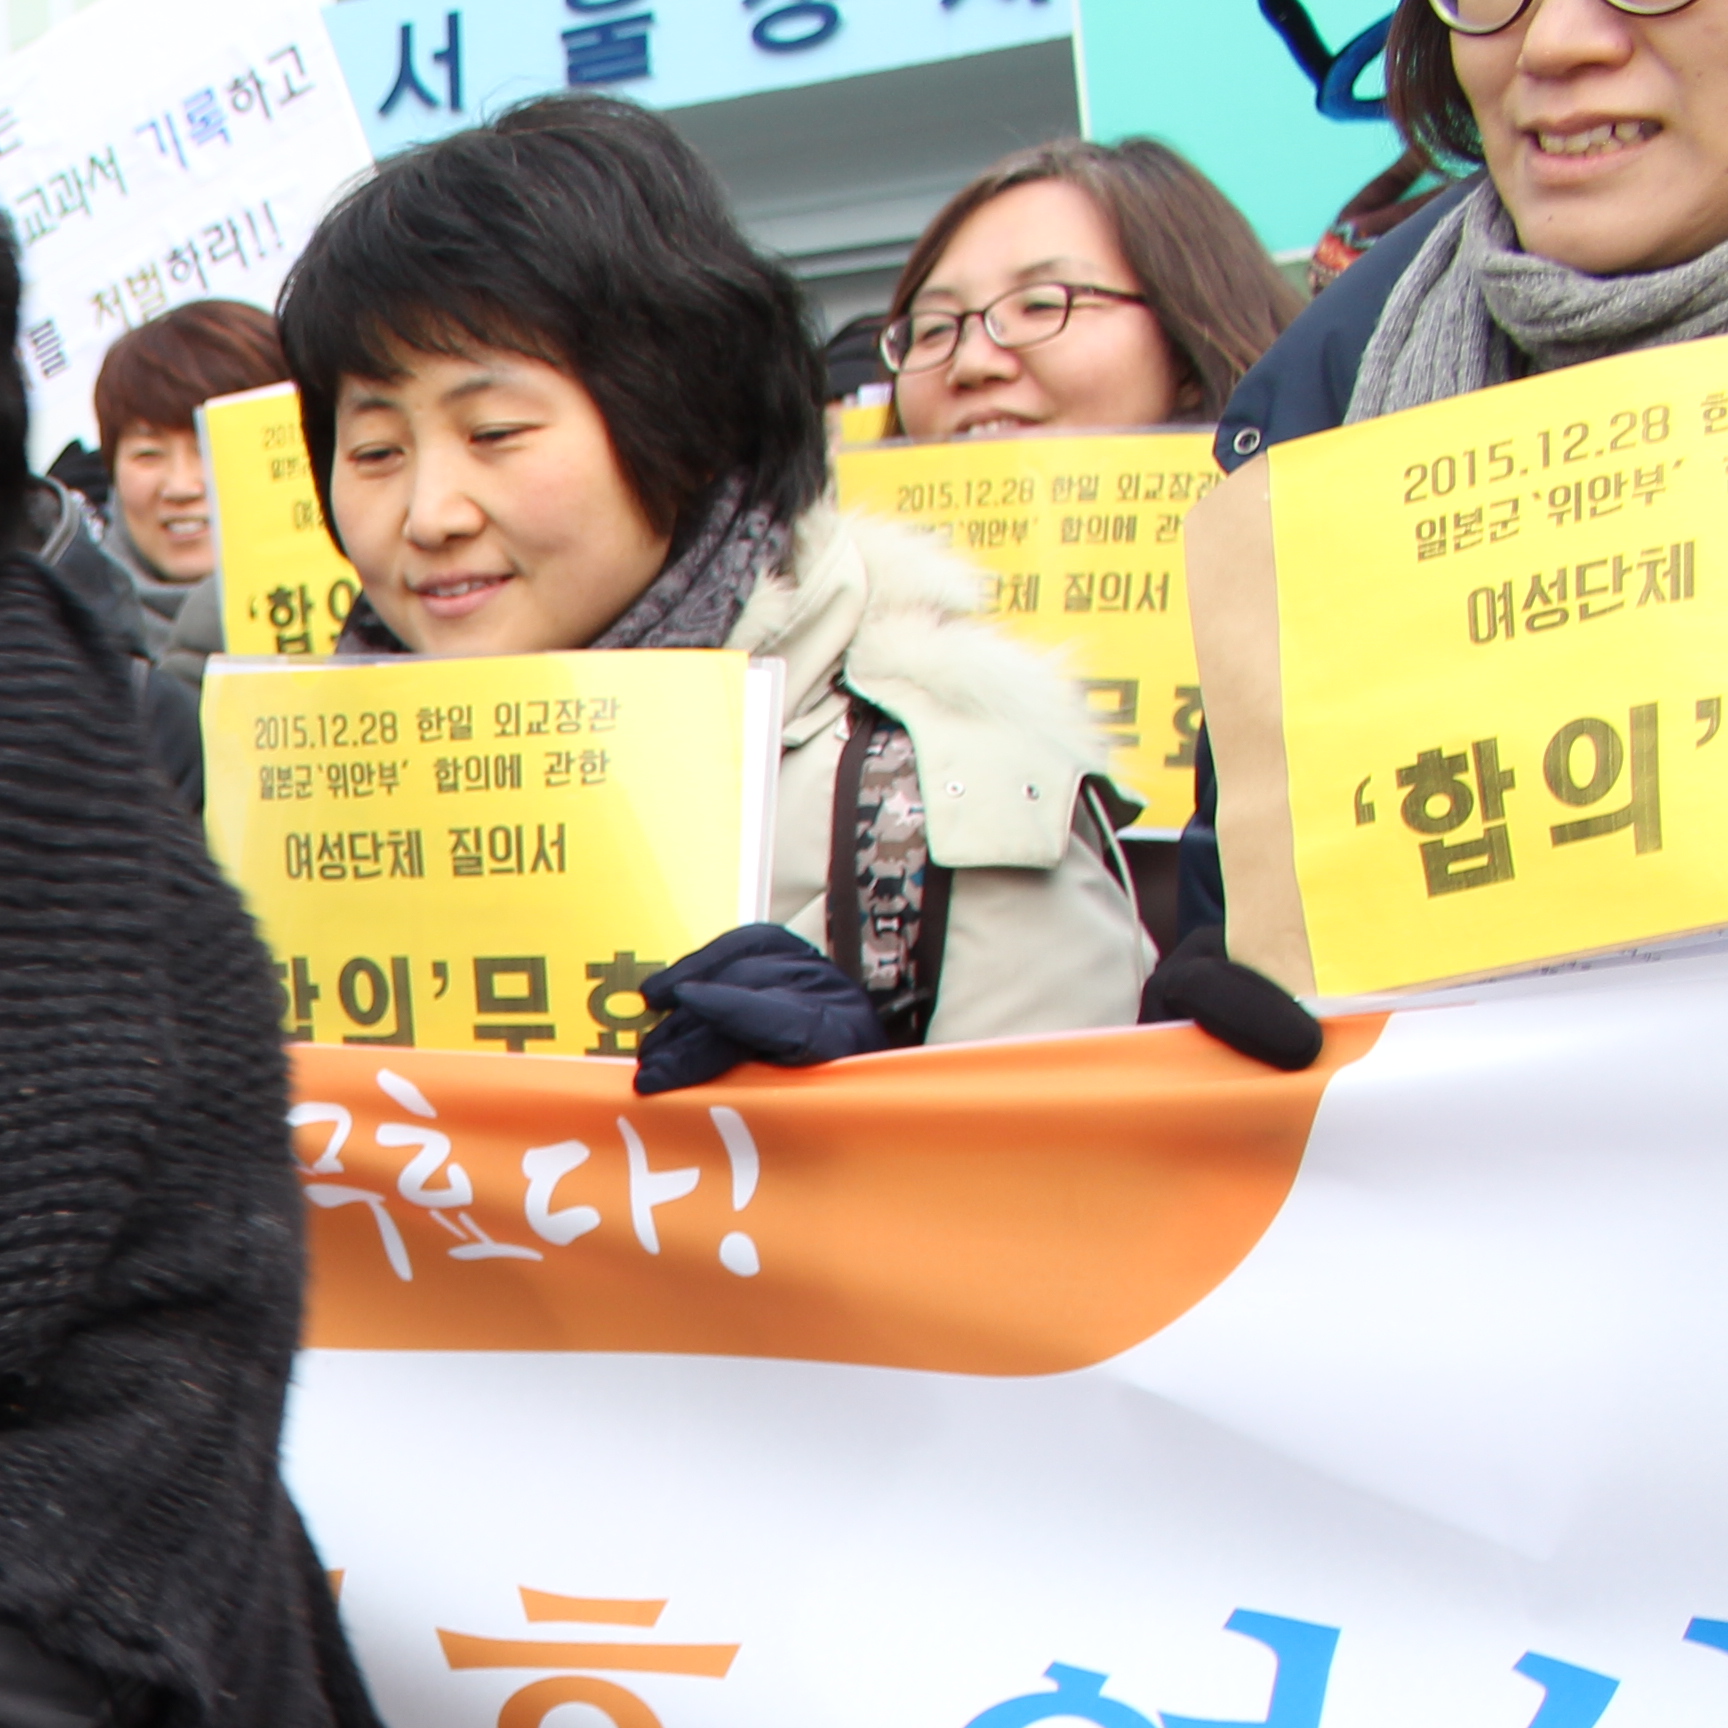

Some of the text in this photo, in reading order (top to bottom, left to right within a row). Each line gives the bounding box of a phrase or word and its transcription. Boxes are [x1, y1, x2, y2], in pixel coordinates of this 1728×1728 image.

[136, 43, 316, 171] 기록하고
[1403, 403, 1671, 505] 2015.12.28
[896, 476, 1035, 513] 2015.12.28
[1063, 570, 1171, 614] 질의서
[1466, 540, 1696, 645] 여성단체
[254, 696, 622, 751] 2015.12.28 한일 외교장관
[432, 753, 523, 794] 합의에
[543, 748, 611, 789] 관한
[284, 823, 568, 882] 여성단체 질의서
